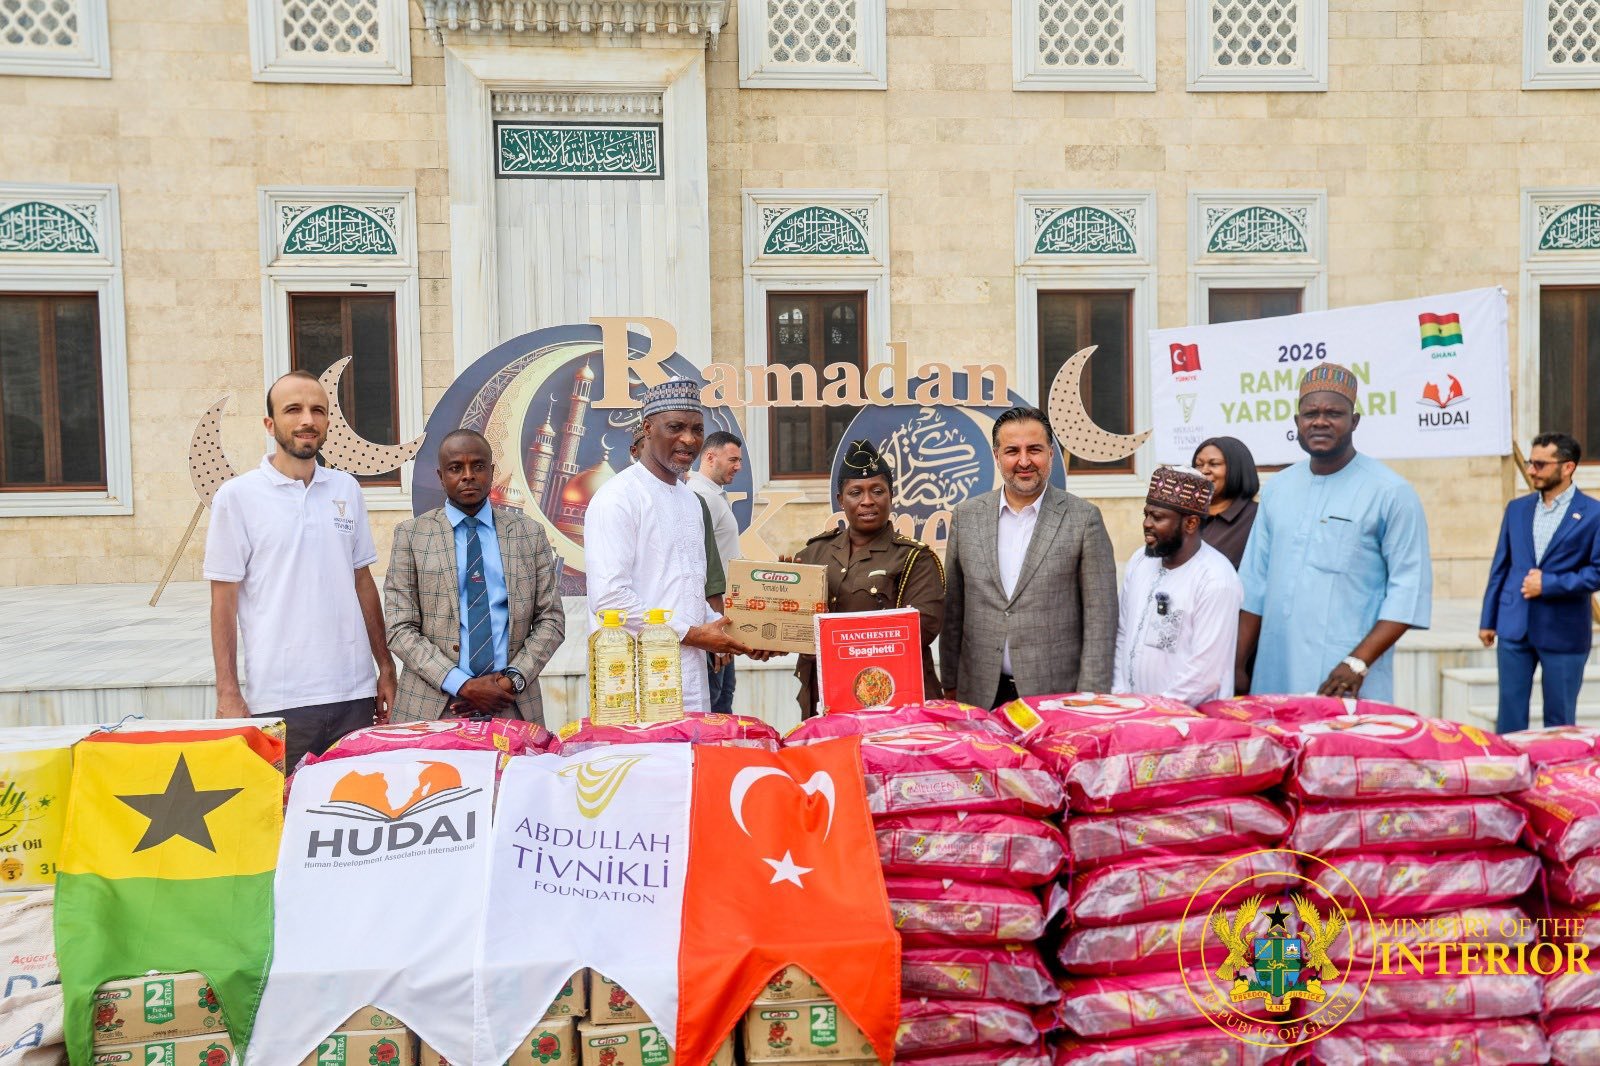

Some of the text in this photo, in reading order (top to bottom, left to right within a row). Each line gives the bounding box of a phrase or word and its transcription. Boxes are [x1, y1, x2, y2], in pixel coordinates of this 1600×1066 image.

[589, 316, 1012, 409] Ramadan
[1278, 342, 1327, 362] 2026
[1419, 411, 1469, 426] HUDAI
[762, 572, 789, 582] Gino
[840, 630, 901, 641] MANCHESTER
[848, 644, 895, 657] Spaghetti
[23, 839, 42, 851] Oil
[307, 811, 476, 858] HUDAI
[515, 817, 670, 853] ABDULLAH
[333, 856, 382, 868] Development
[384, 849, 426, 861] Association
[428, 843, 475, 855] International
[534, 880, 655, 904] FOUNDATION
[145, 983, 164, 1008] 2
[164, 981, 174, 1006] EXTRA
[812, 1007, 828, 1030] 2
[319, 1037, 337, 1061] 2
[337, 1037, 345, 1061] EXTRA
[597, 1037, 619, 1045] Gino
[642, 1029, 659, 1052] 2
[98, 1055, 122, 1063] Gino
[147, 1045, 165, 1066] 2
